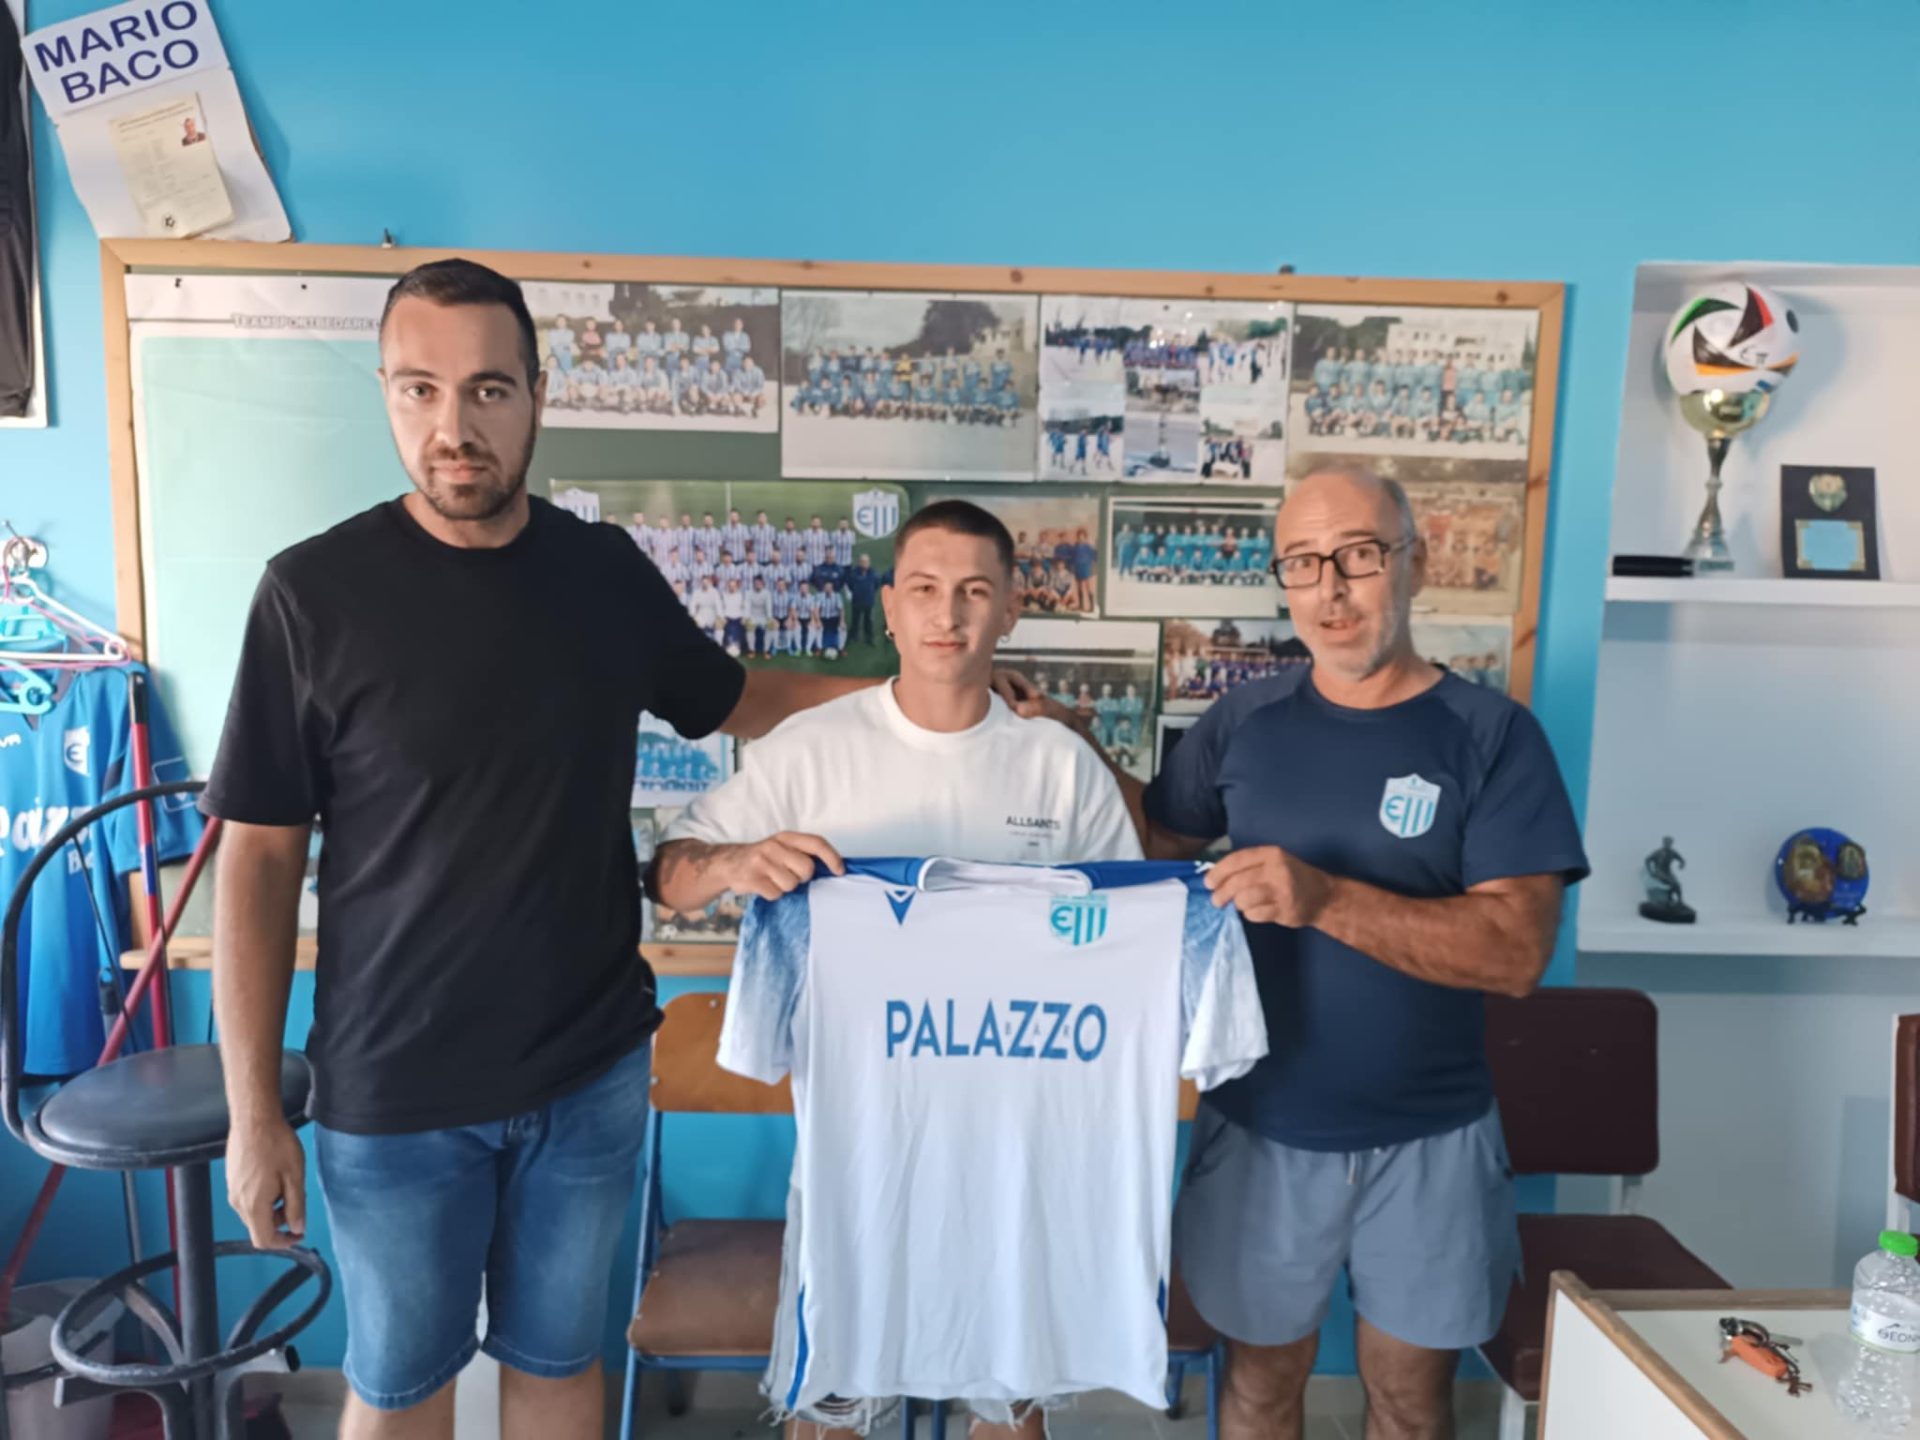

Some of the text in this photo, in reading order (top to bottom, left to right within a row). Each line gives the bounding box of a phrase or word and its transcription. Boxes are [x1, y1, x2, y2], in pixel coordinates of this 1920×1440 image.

[34, 1, 198, 72] MARIO
[60, 39, 199, 103] BACO
[886, 998, 1107, 1062] PALAZZO
